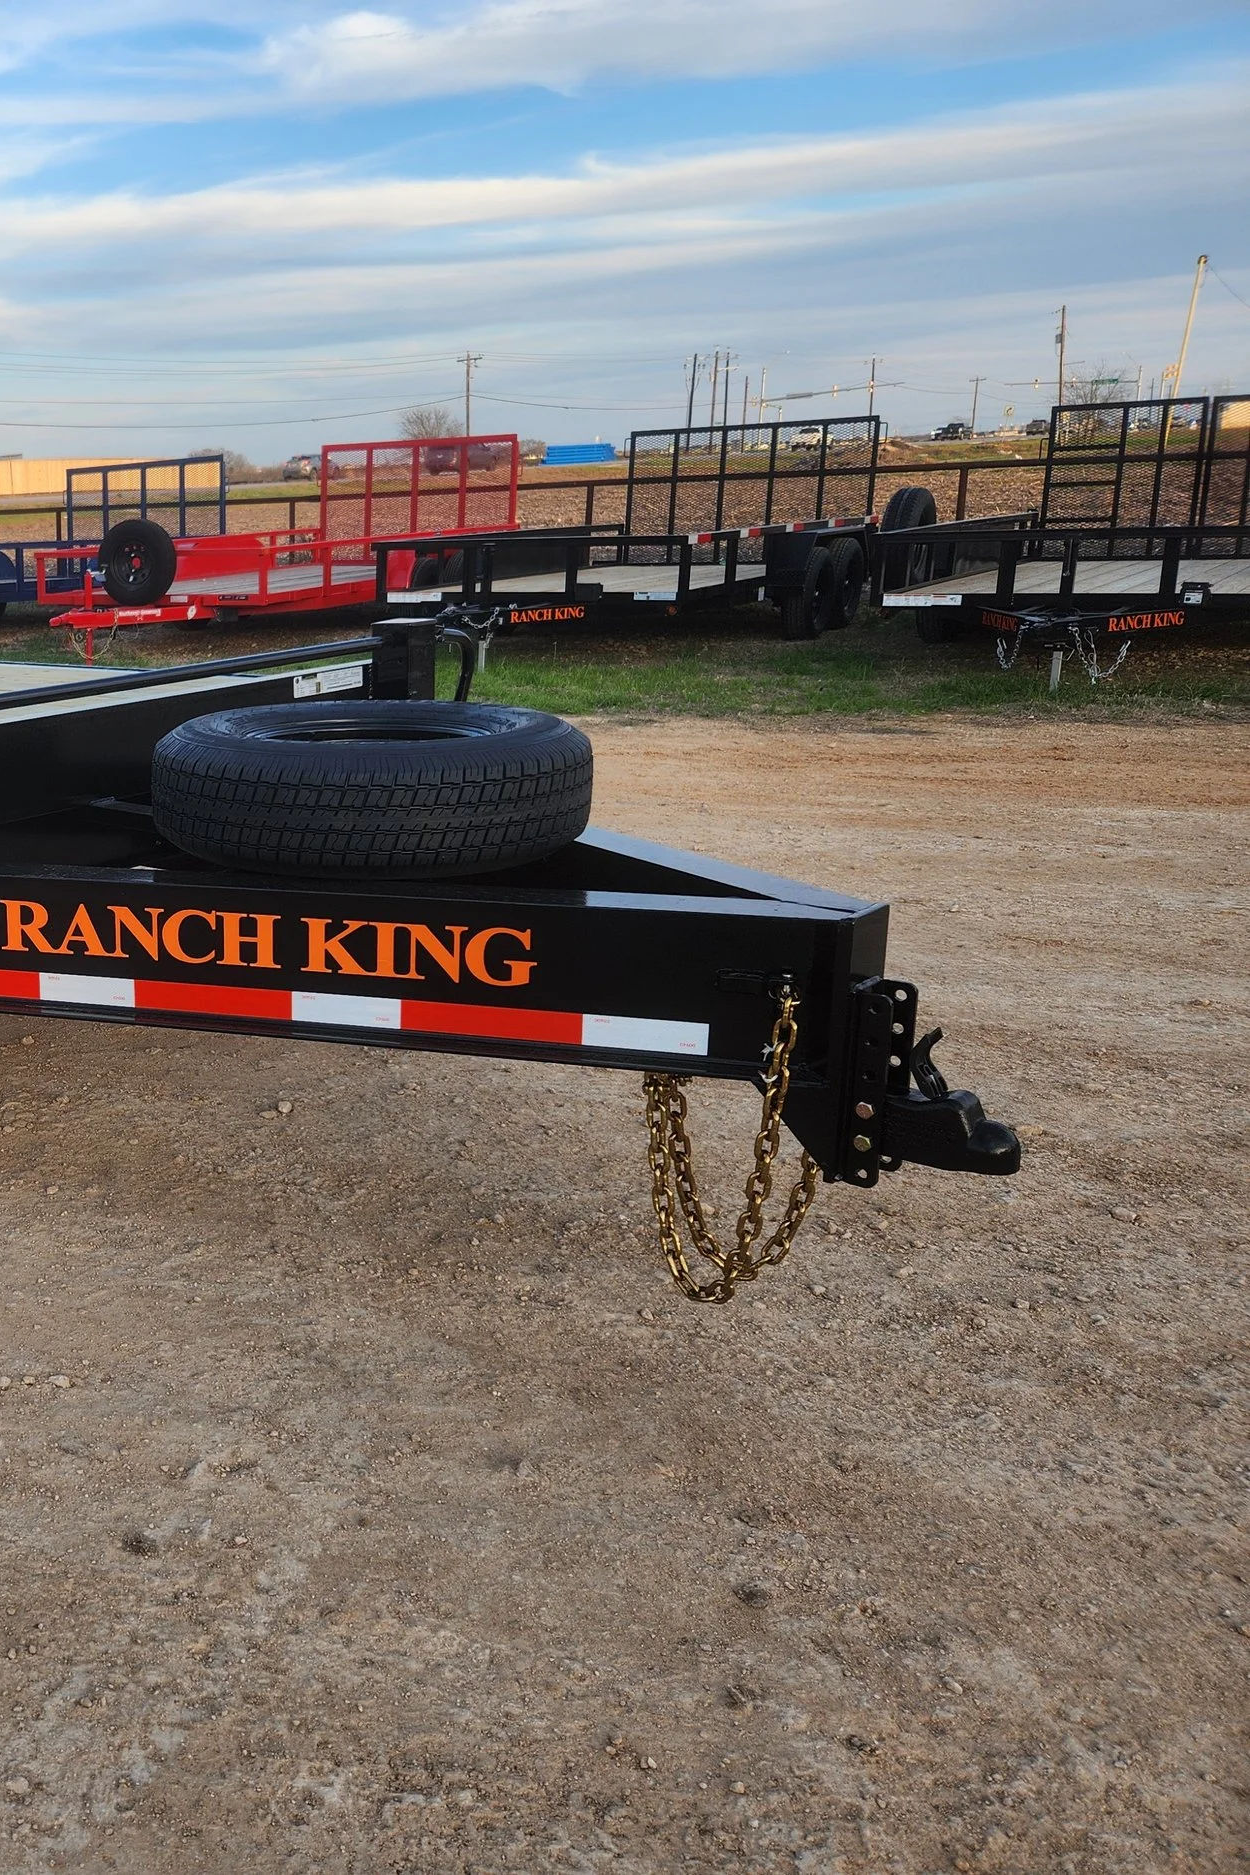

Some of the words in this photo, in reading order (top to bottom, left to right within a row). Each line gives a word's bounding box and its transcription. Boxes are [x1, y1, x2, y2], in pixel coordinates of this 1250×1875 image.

[510, 609, 551, 623] RANCH
[554, 606, 585, 620] KING
[1108, 613, 1152, 632] RANCH
[1153, 611, 1184, 628] KING
[0, 899, 282, 969] RANCH
[300, 917, 538, 987] KING
